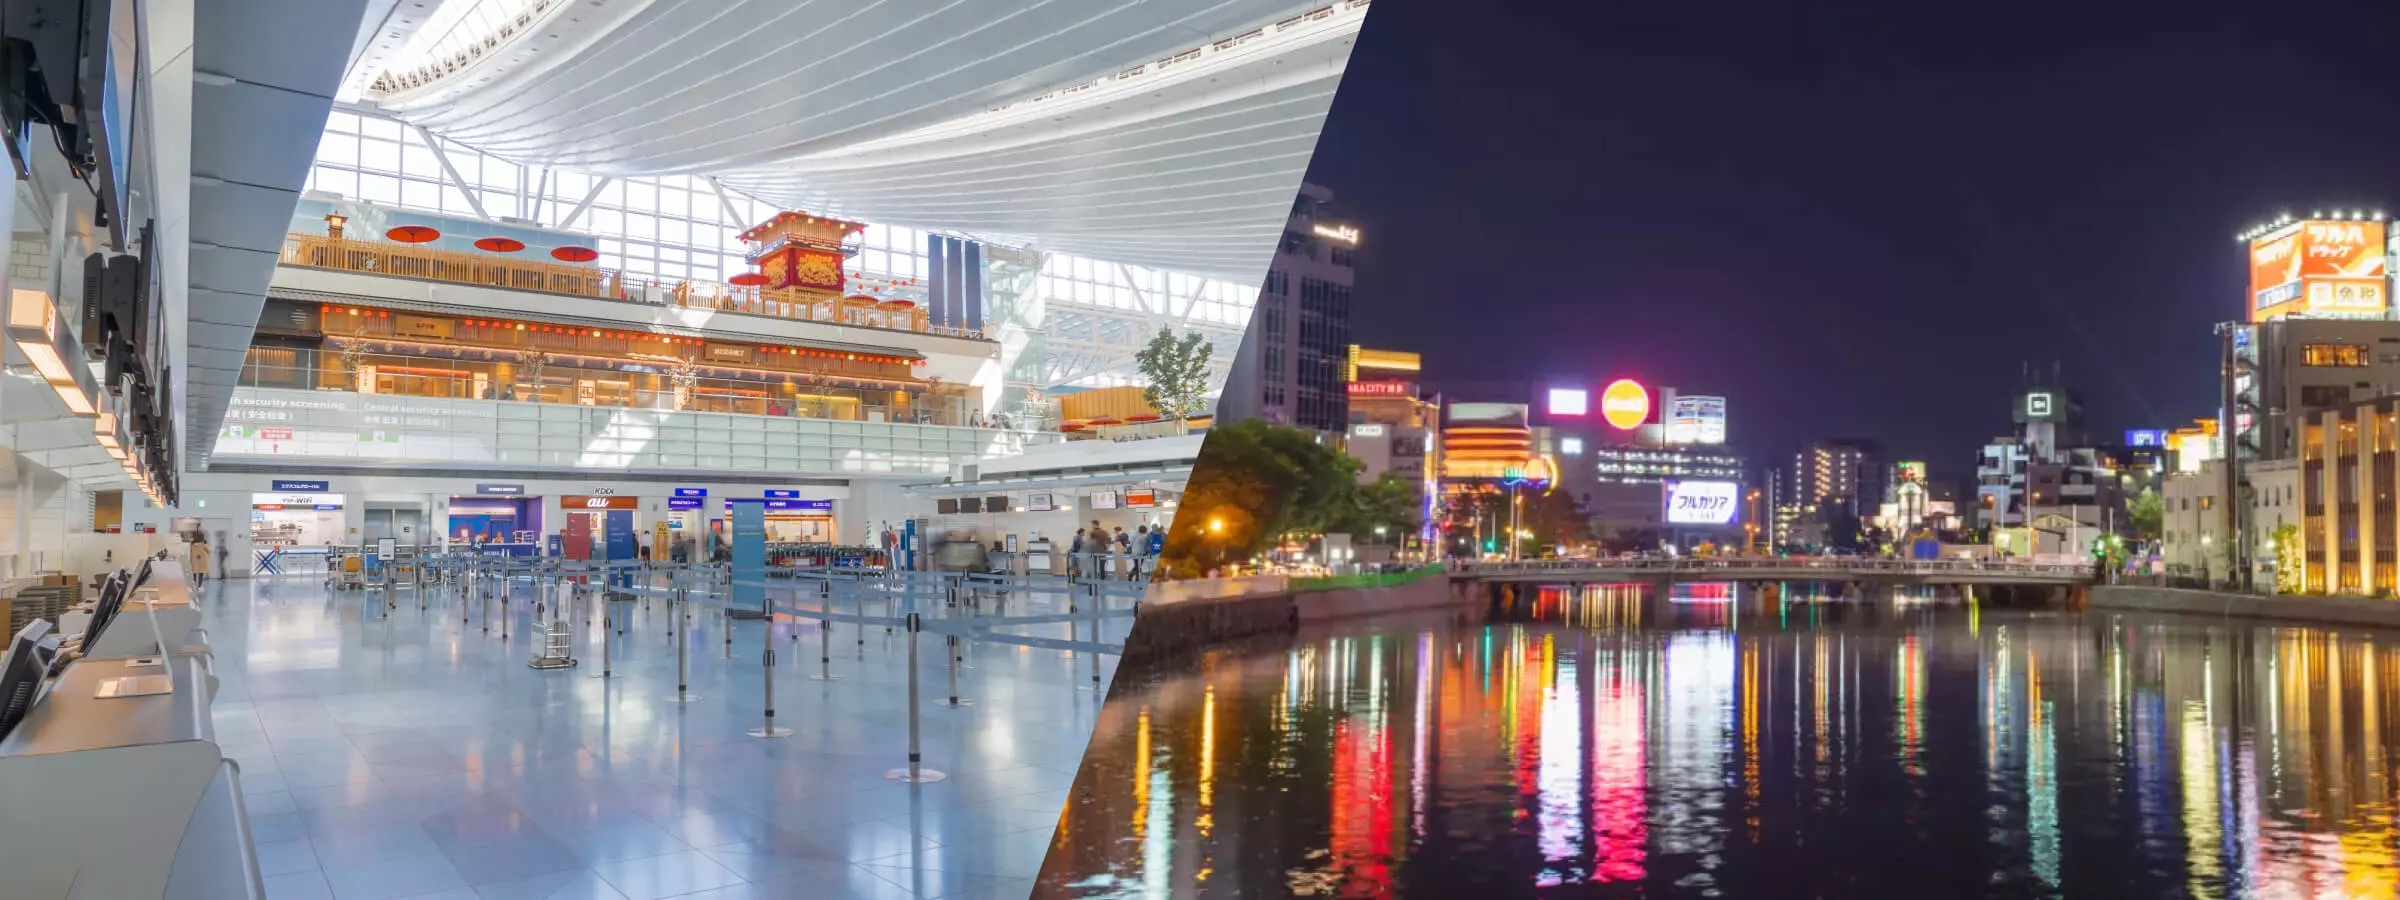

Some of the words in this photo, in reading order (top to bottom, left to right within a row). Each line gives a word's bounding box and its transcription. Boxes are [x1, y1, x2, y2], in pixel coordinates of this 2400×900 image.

[242, 398, 287, 407] security
[289, 401, 346, 411] screening
[364, 403, 398, 412] Central
[594, 487, 614, 495] KDDI
[587, 497, 610, 508] au
[1678, 495, 1729, 509] フルカリア
